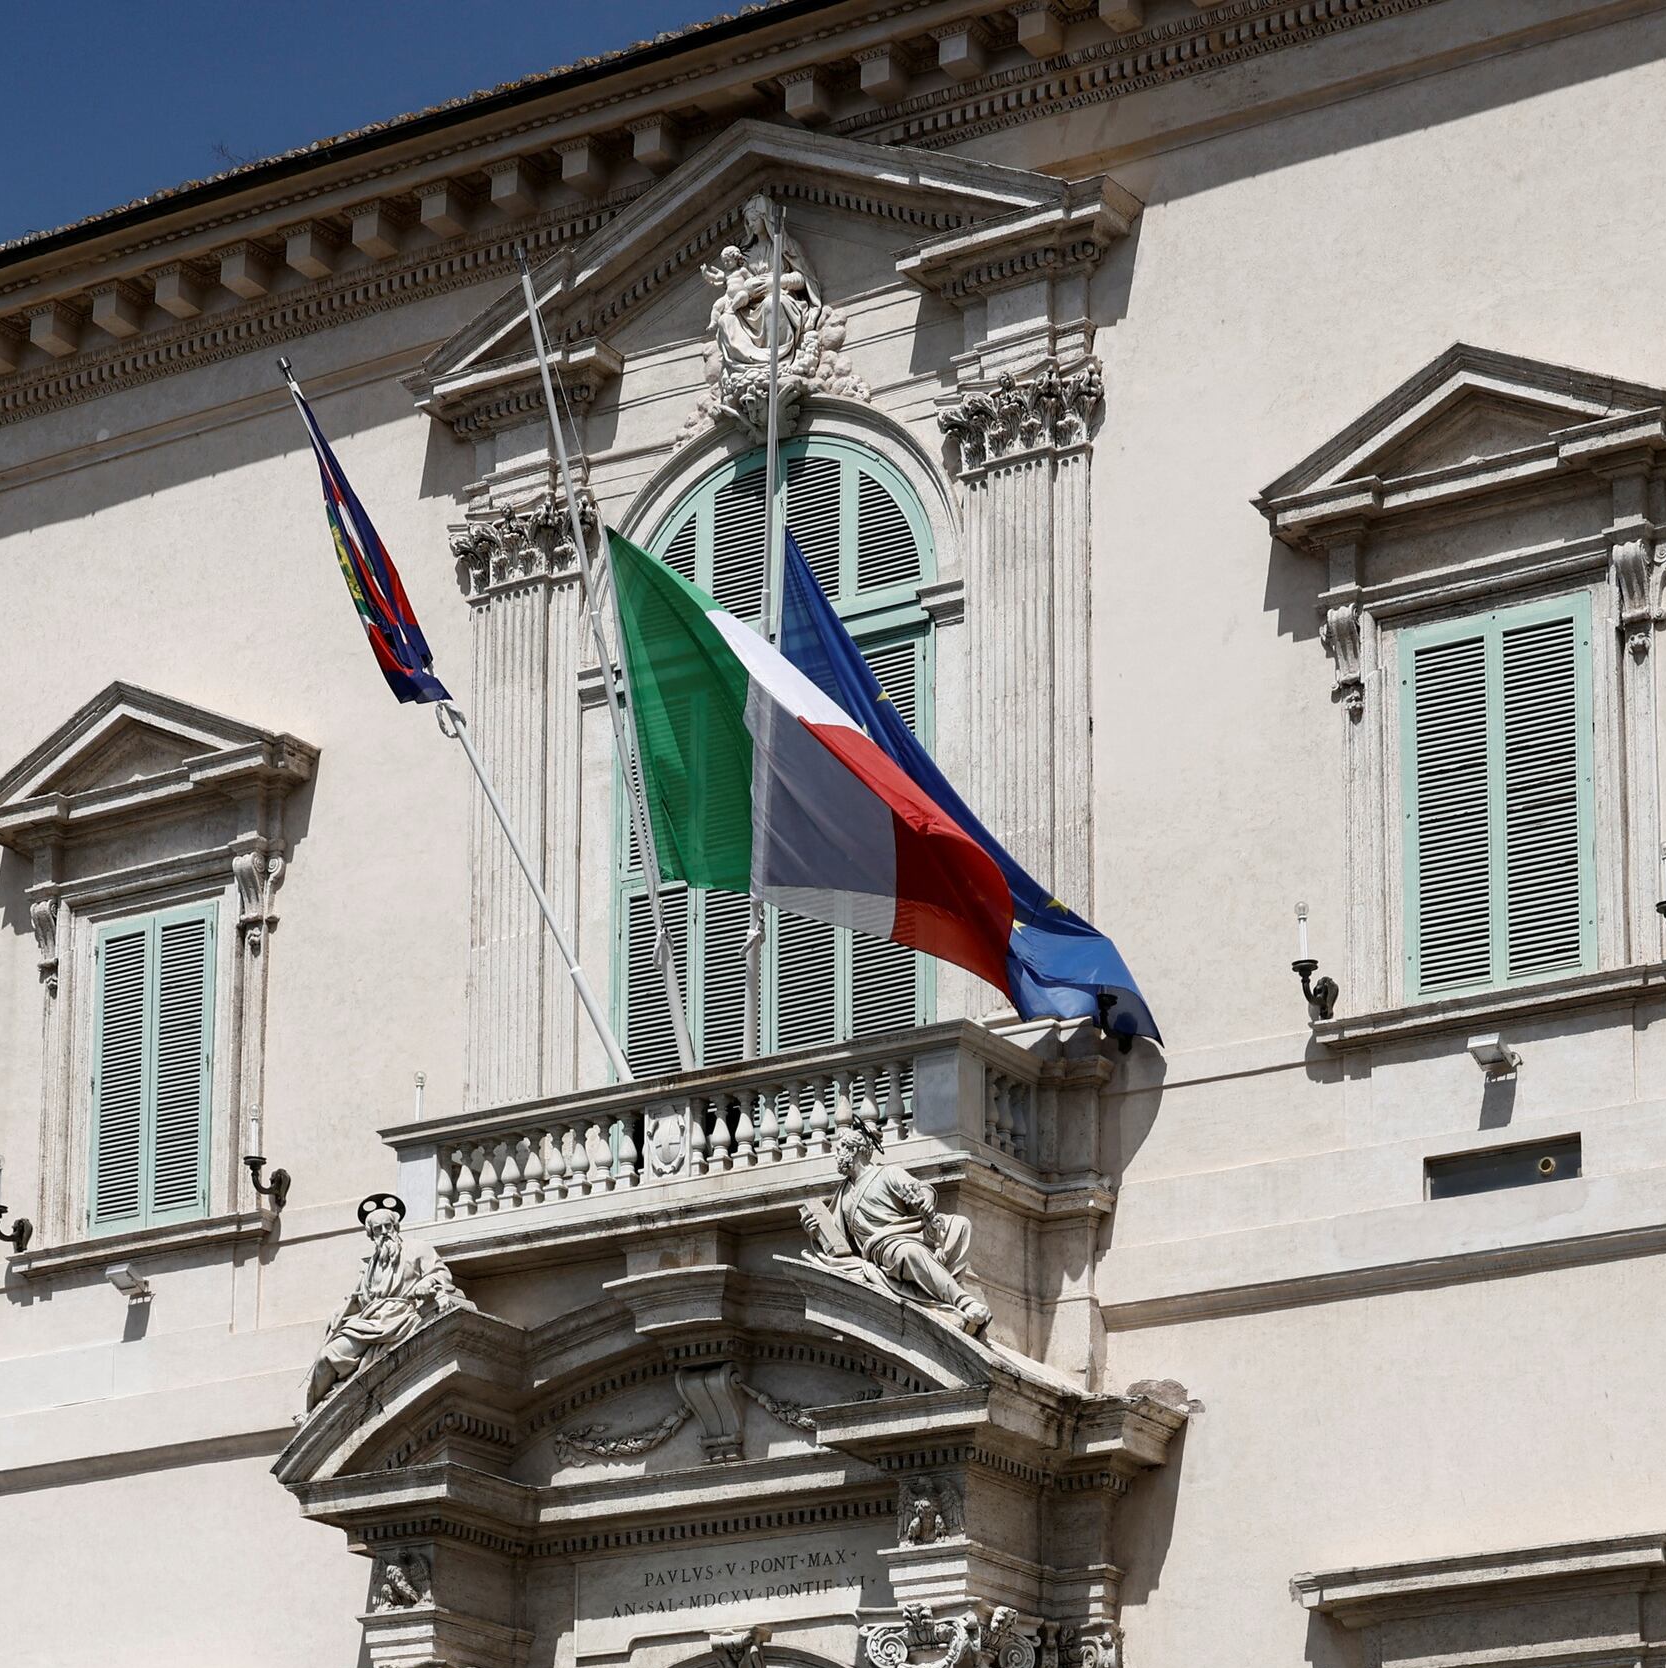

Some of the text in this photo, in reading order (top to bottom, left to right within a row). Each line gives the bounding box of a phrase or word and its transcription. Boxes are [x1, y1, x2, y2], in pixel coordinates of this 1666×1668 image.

[644, 1549, 846, 1587] PAVLVS V PONT MAX
[612, 1575, 865, 1619] AN SAL MDCXV PONTIF XI
